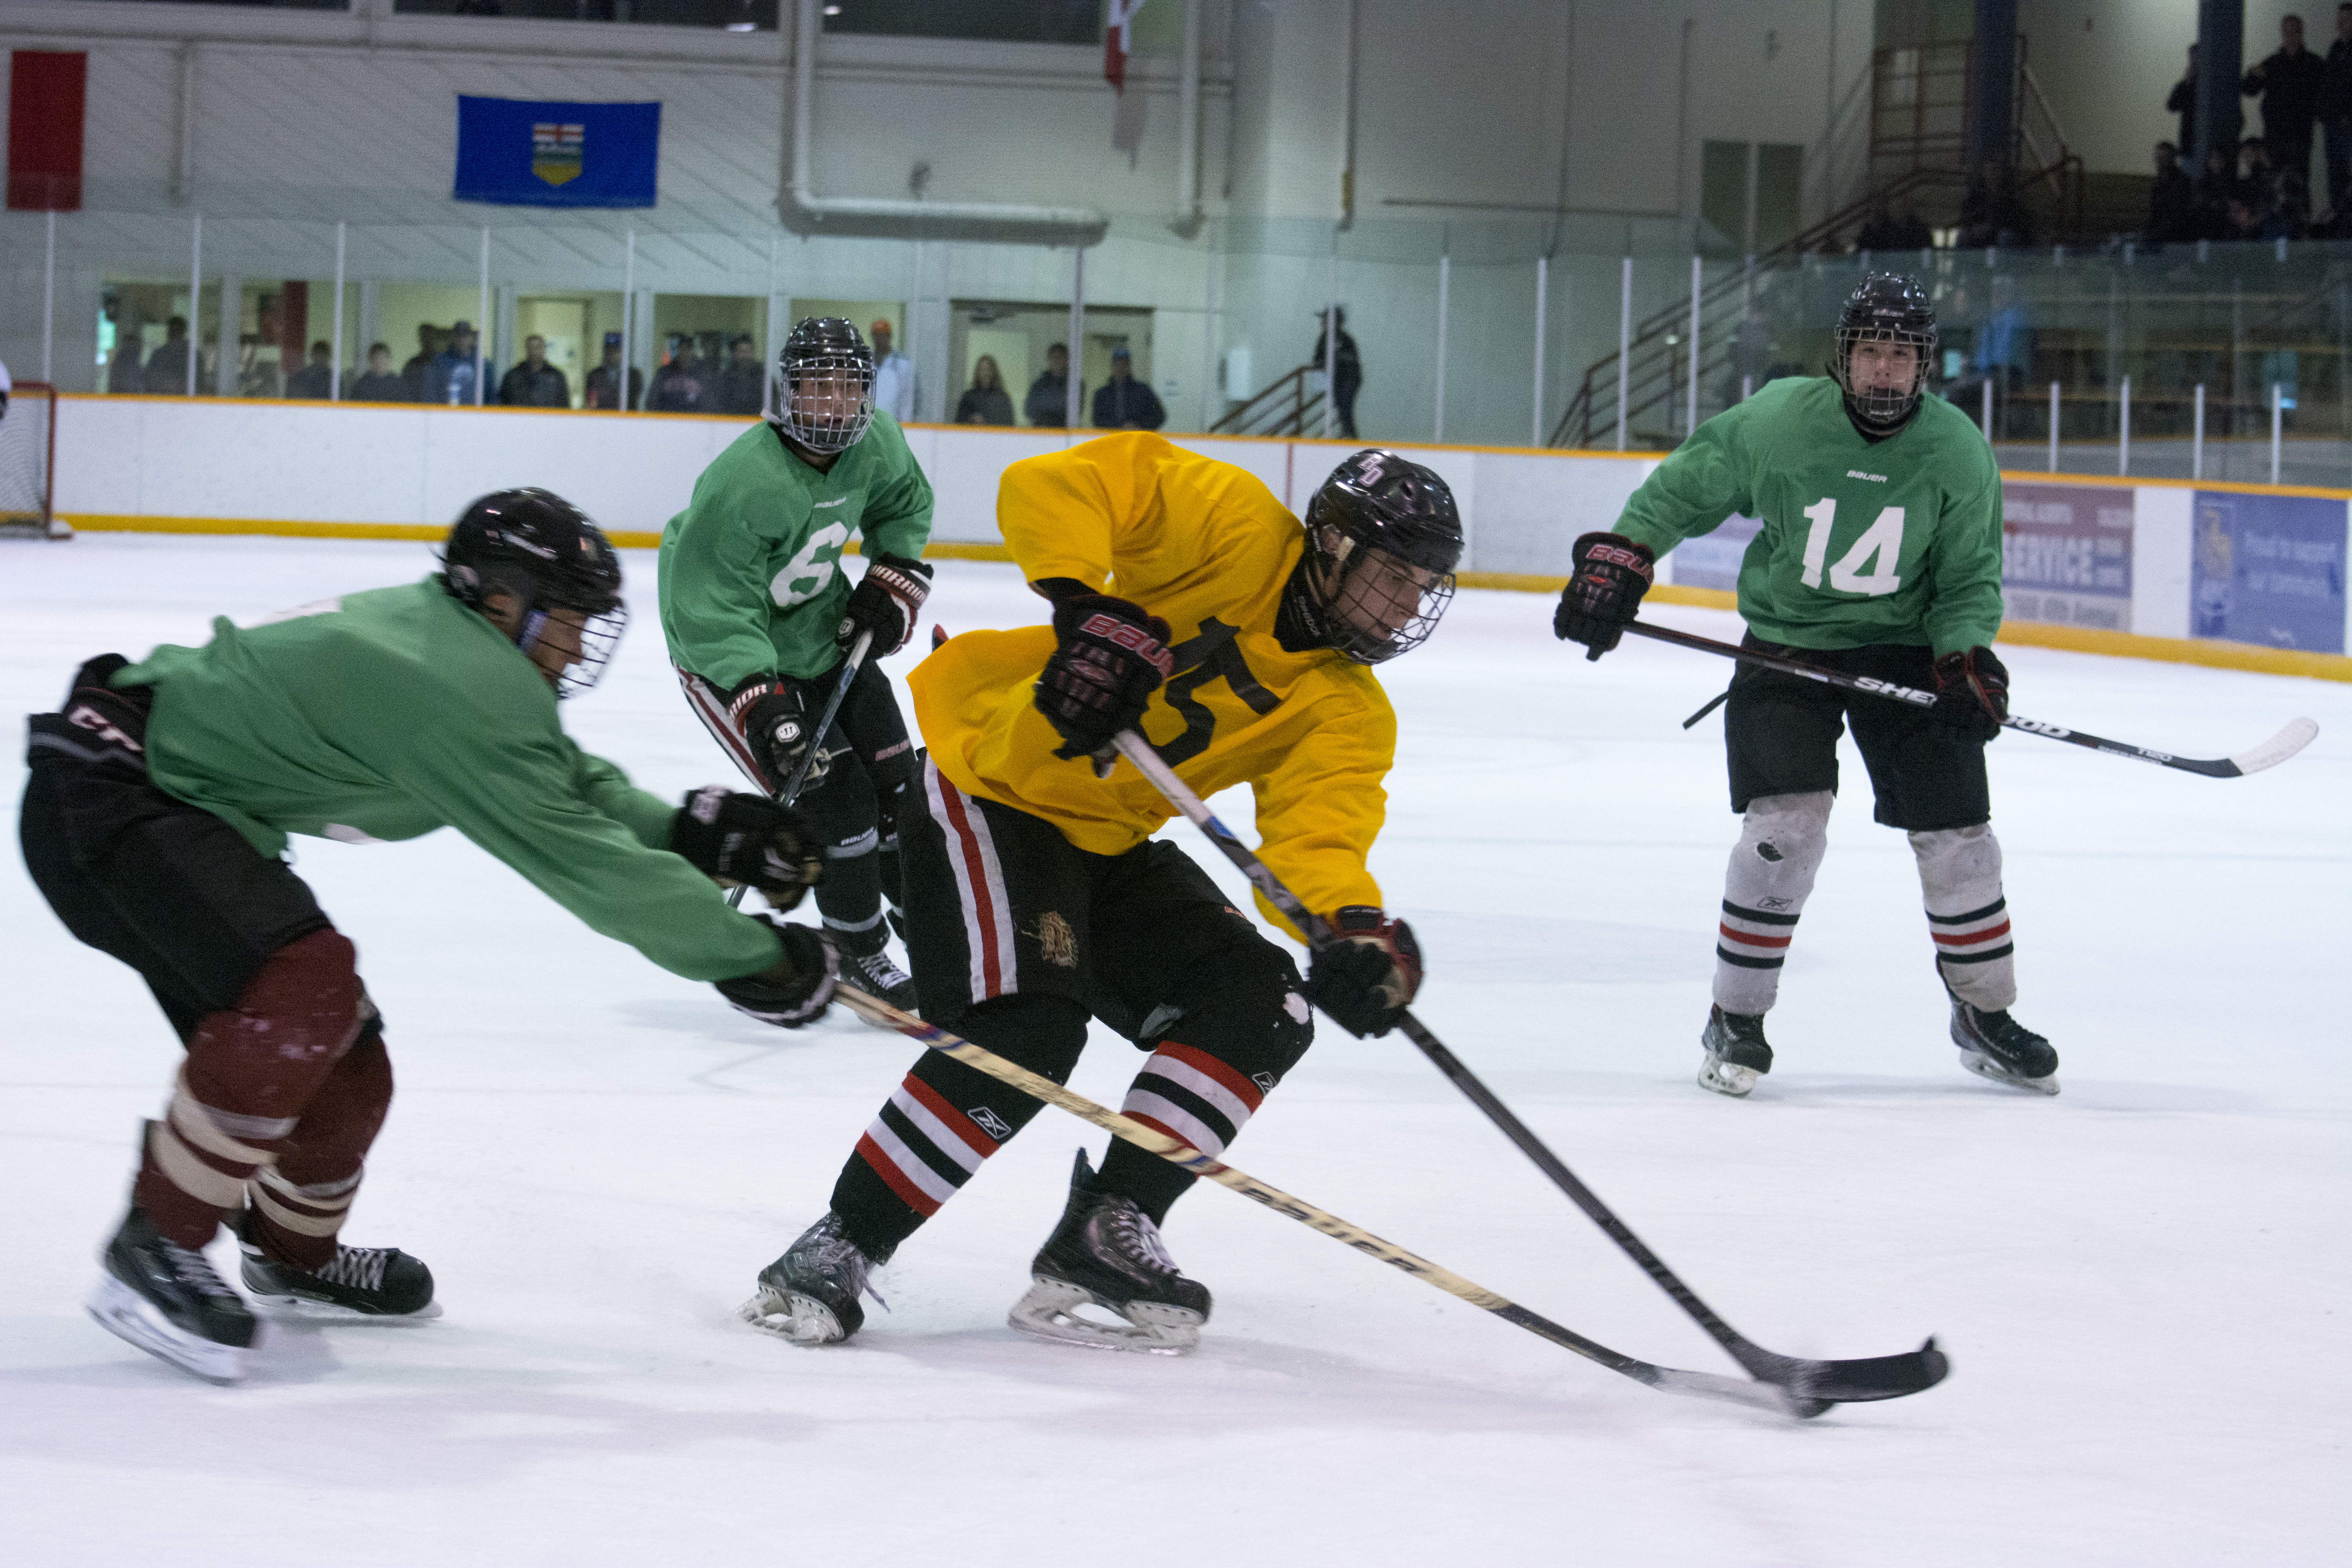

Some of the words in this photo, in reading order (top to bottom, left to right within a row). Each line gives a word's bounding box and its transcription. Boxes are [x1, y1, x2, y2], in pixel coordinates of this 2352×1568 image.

[1847, 470, 1888, 483] BAUER
[770, 520, 848, 608] 6
[1800, 497, 1905, 597] 14
[1854, 676, 1938, 705] SHE
